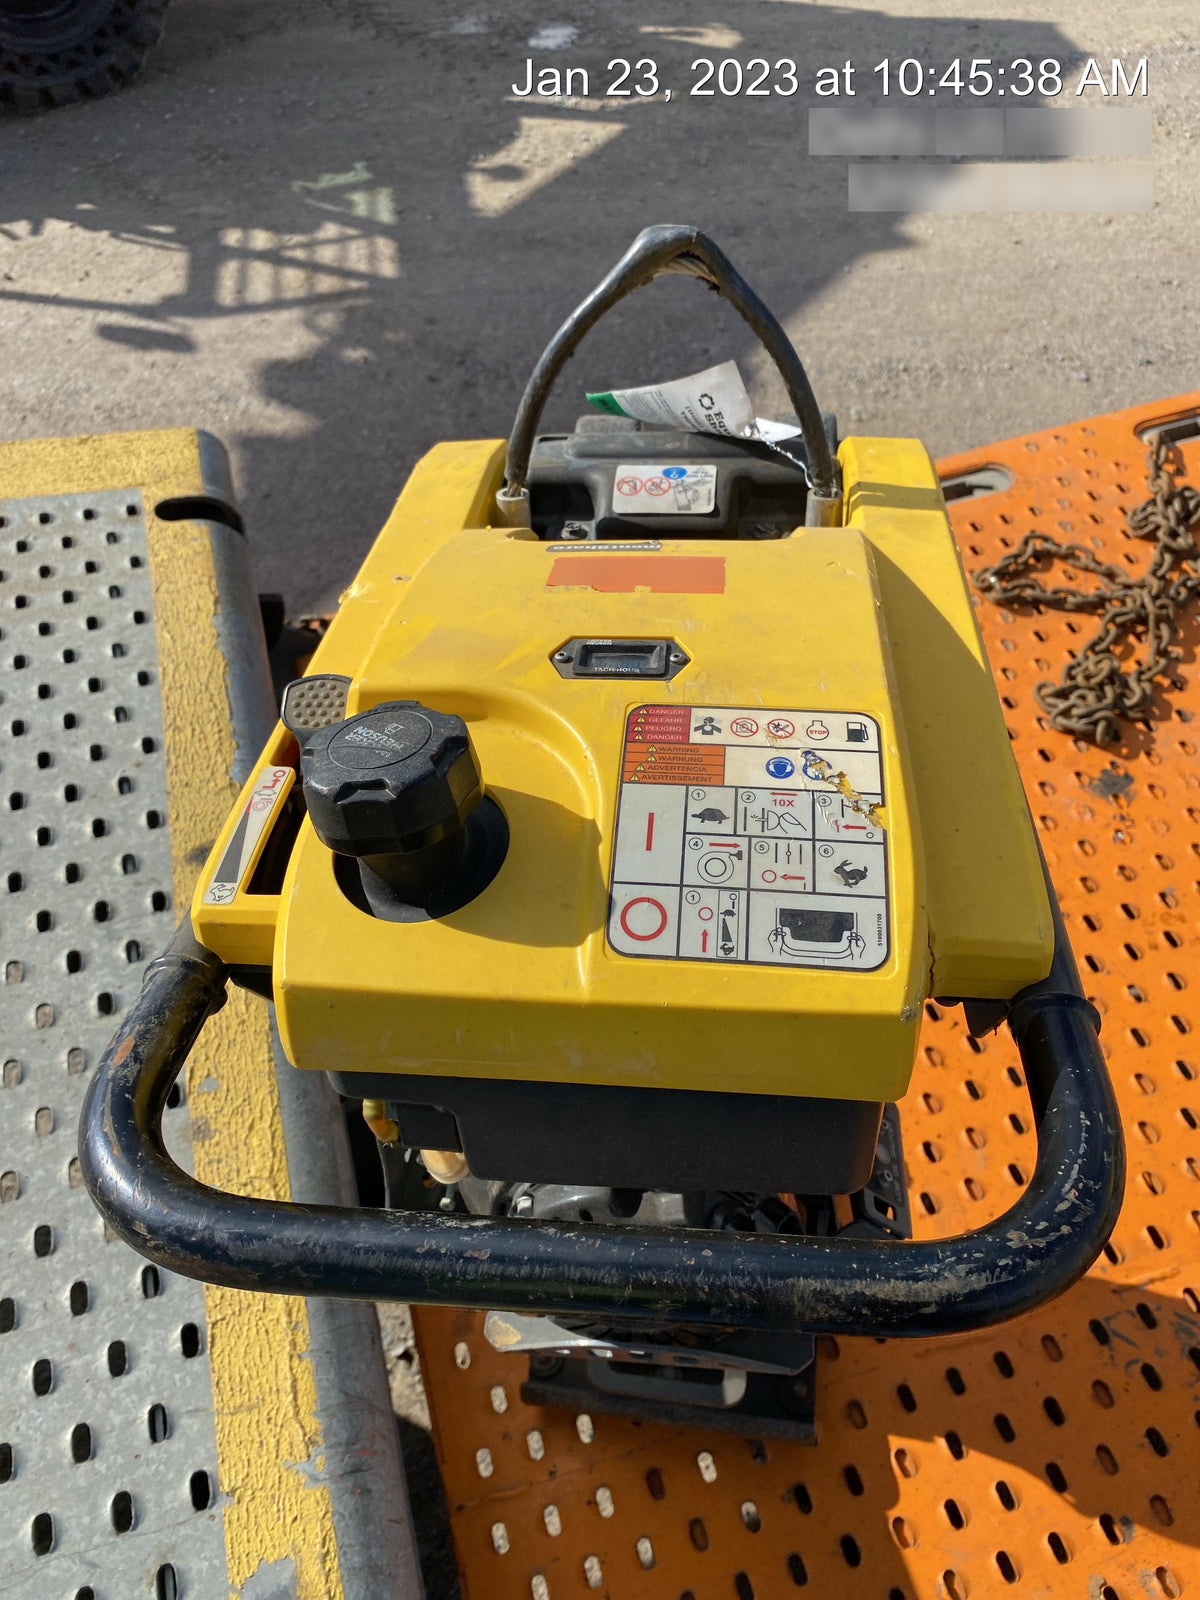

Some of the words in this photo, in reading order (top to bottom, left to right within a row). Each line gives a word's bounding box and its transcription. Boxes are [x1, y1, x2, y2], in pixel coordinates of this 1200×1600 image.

[658, 755, 703, 763] WARNUNG
[647, 764, 708, 772] ADVERTENCIA
[641, 774, 713, 782] AVERTISSEMENT
[772, 799, 795, 808] 10X
